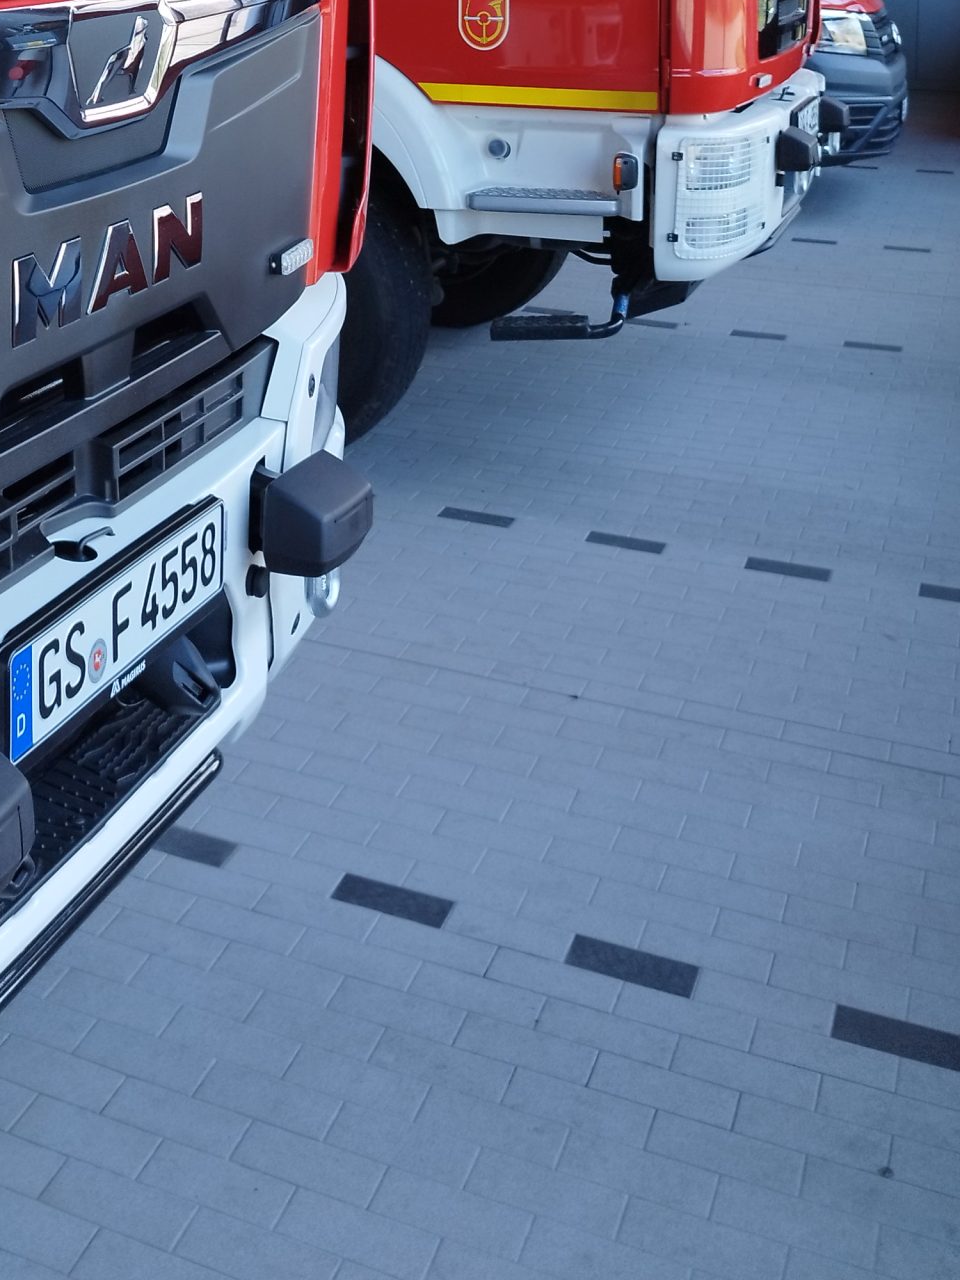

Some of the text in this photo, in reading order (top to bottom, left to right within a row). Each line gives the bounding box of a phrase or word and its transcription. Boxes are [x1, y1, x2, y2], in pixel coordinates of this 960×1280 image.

[11, 191, 203, 349] MAN
[39, 522, 217, 720] GS F 4558
[121, 659, 146, 690] MAGIRUS
[16, 713, 26, 738] D
